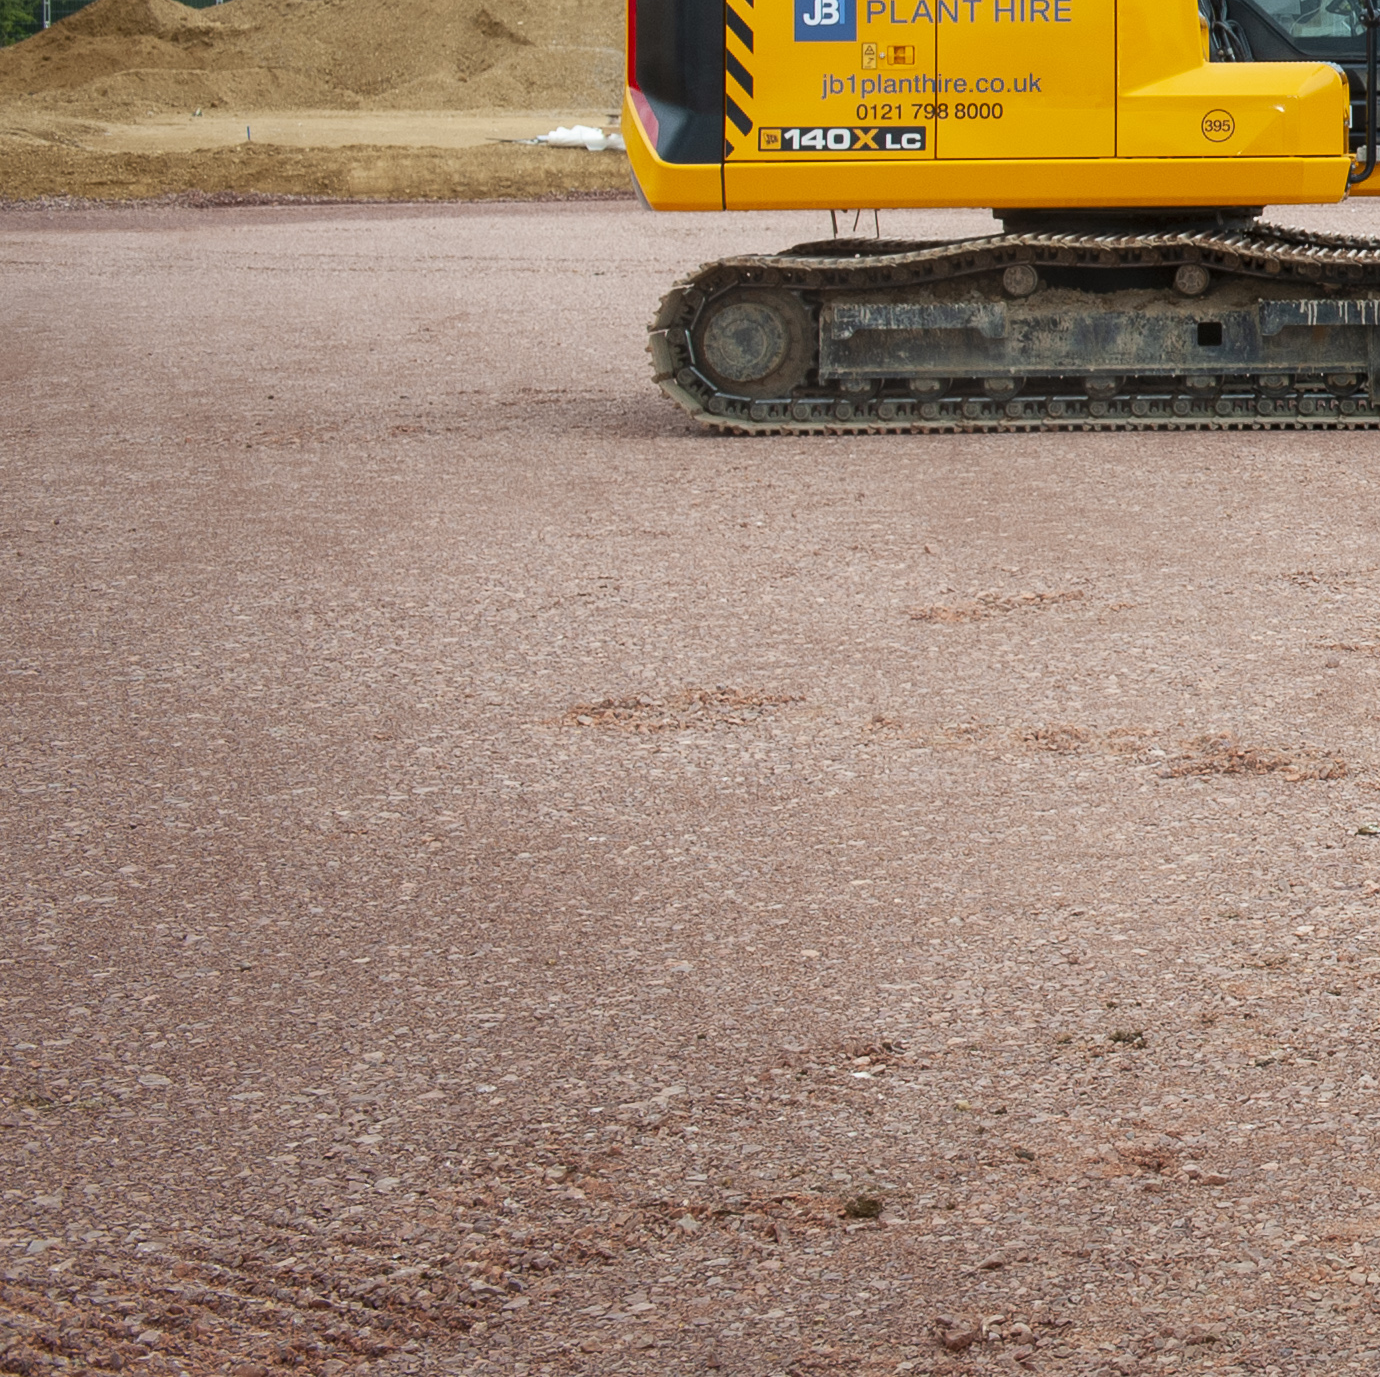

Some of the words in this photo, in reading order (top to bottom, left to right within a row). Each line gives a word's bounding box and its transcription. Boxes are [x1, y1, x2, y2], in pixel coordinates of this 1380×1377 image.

[821, 73, 1042, 100] jb1planthire.co.uk
[856, 103, 903, 121] 0121
[912, 103, 950, 120] 798
[954, 103, 1004, 119] 8000
[1205, 120, 1230, 132] 395
[783, 128, 879, 150] 140X
[885, 133, 922, 149] LC
